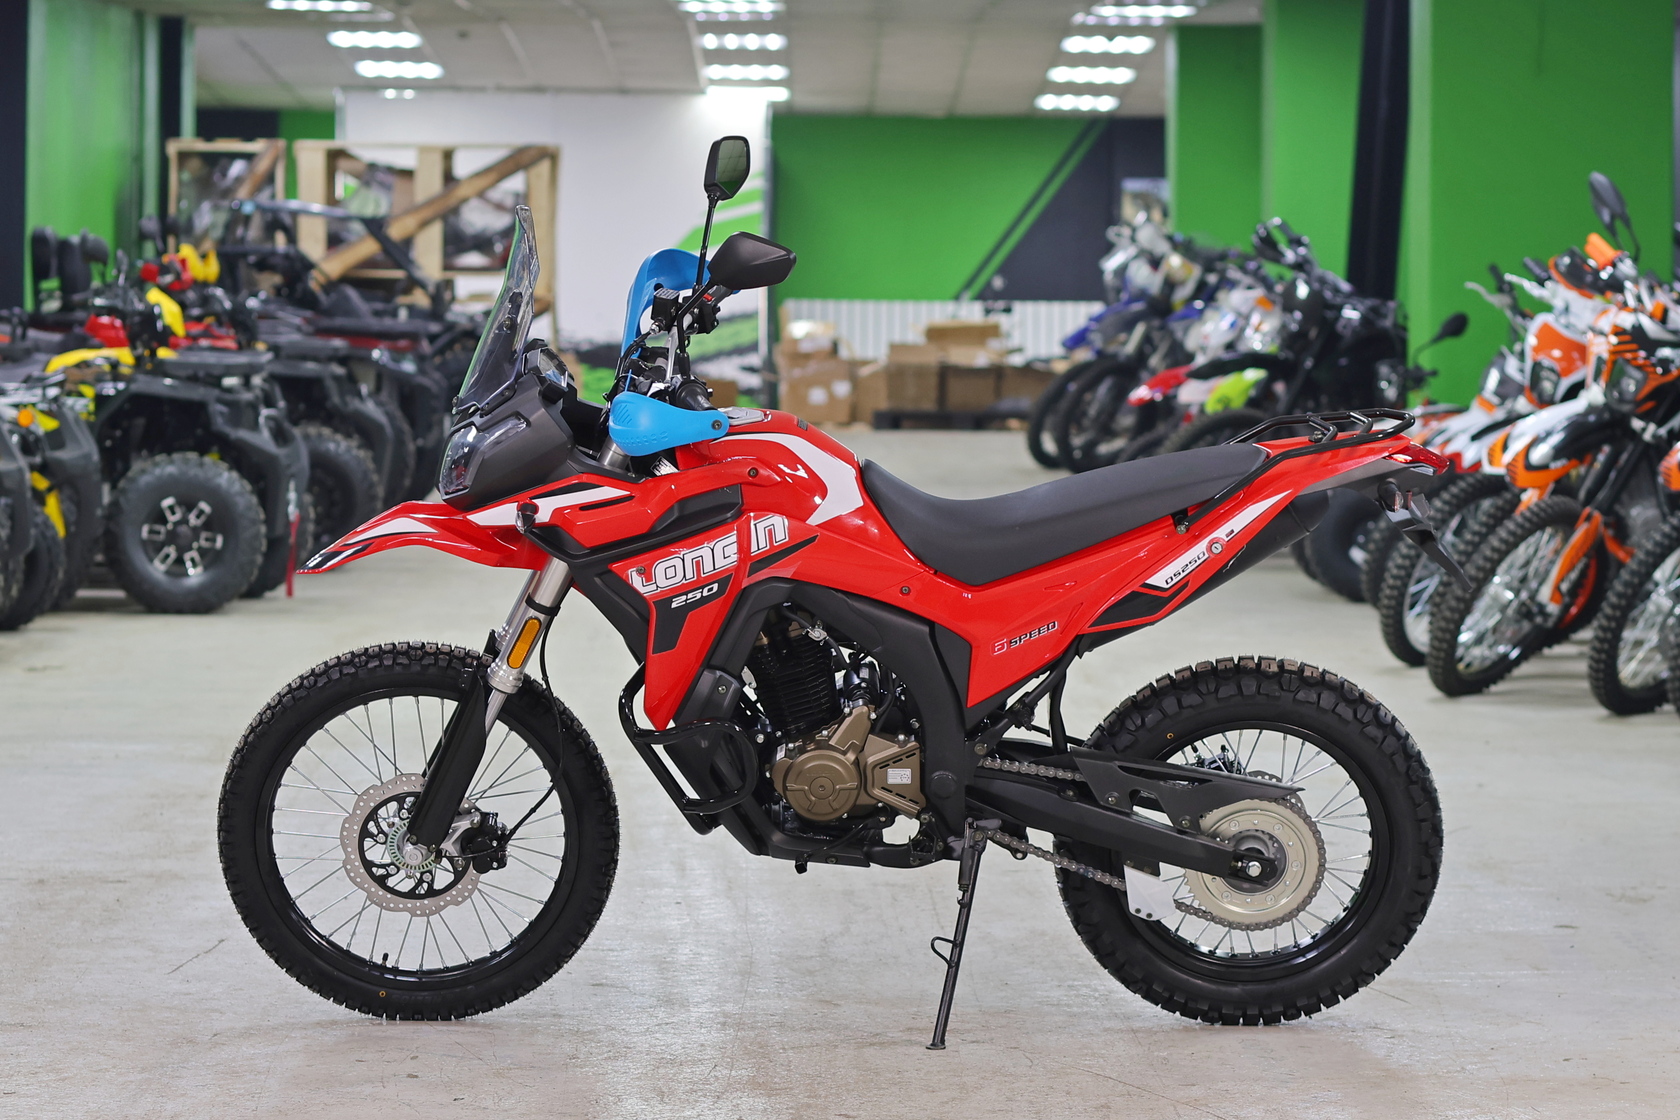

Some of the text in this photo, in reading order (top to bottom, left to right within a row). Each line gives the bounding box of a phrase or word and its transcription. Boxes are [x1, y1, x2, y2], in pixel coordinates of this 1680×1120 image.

[1165, 551, 1206, 586] DS250
[671, 583, 719, 609] 250
[1010, 621, 1058, 648] SPEED
